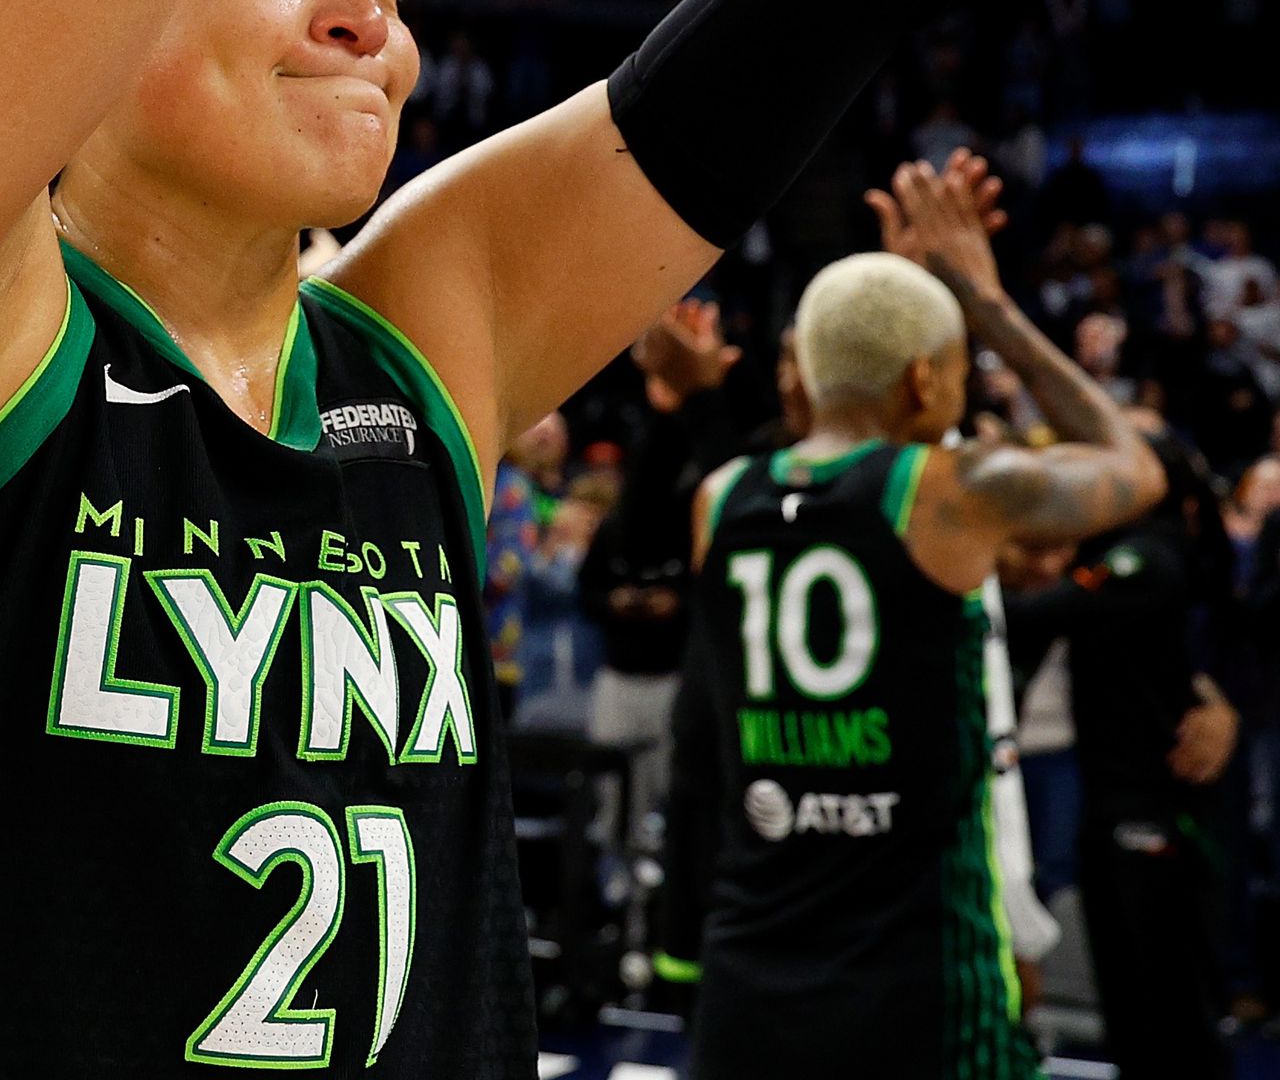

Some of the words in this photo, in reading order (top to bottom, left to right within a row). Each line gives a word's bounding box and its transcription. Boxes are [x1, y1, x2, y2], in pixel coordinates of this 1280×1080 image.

[328, 426, 403, 448] NSURANCE
[46, 549, 477, 767] LYNX
[727, 543, 880, 701] 10
[737, 706, 892, 767] WILLIAMS
[795, 791, 900, 837] AT&T
[184, 800, 417, 1070] 21
